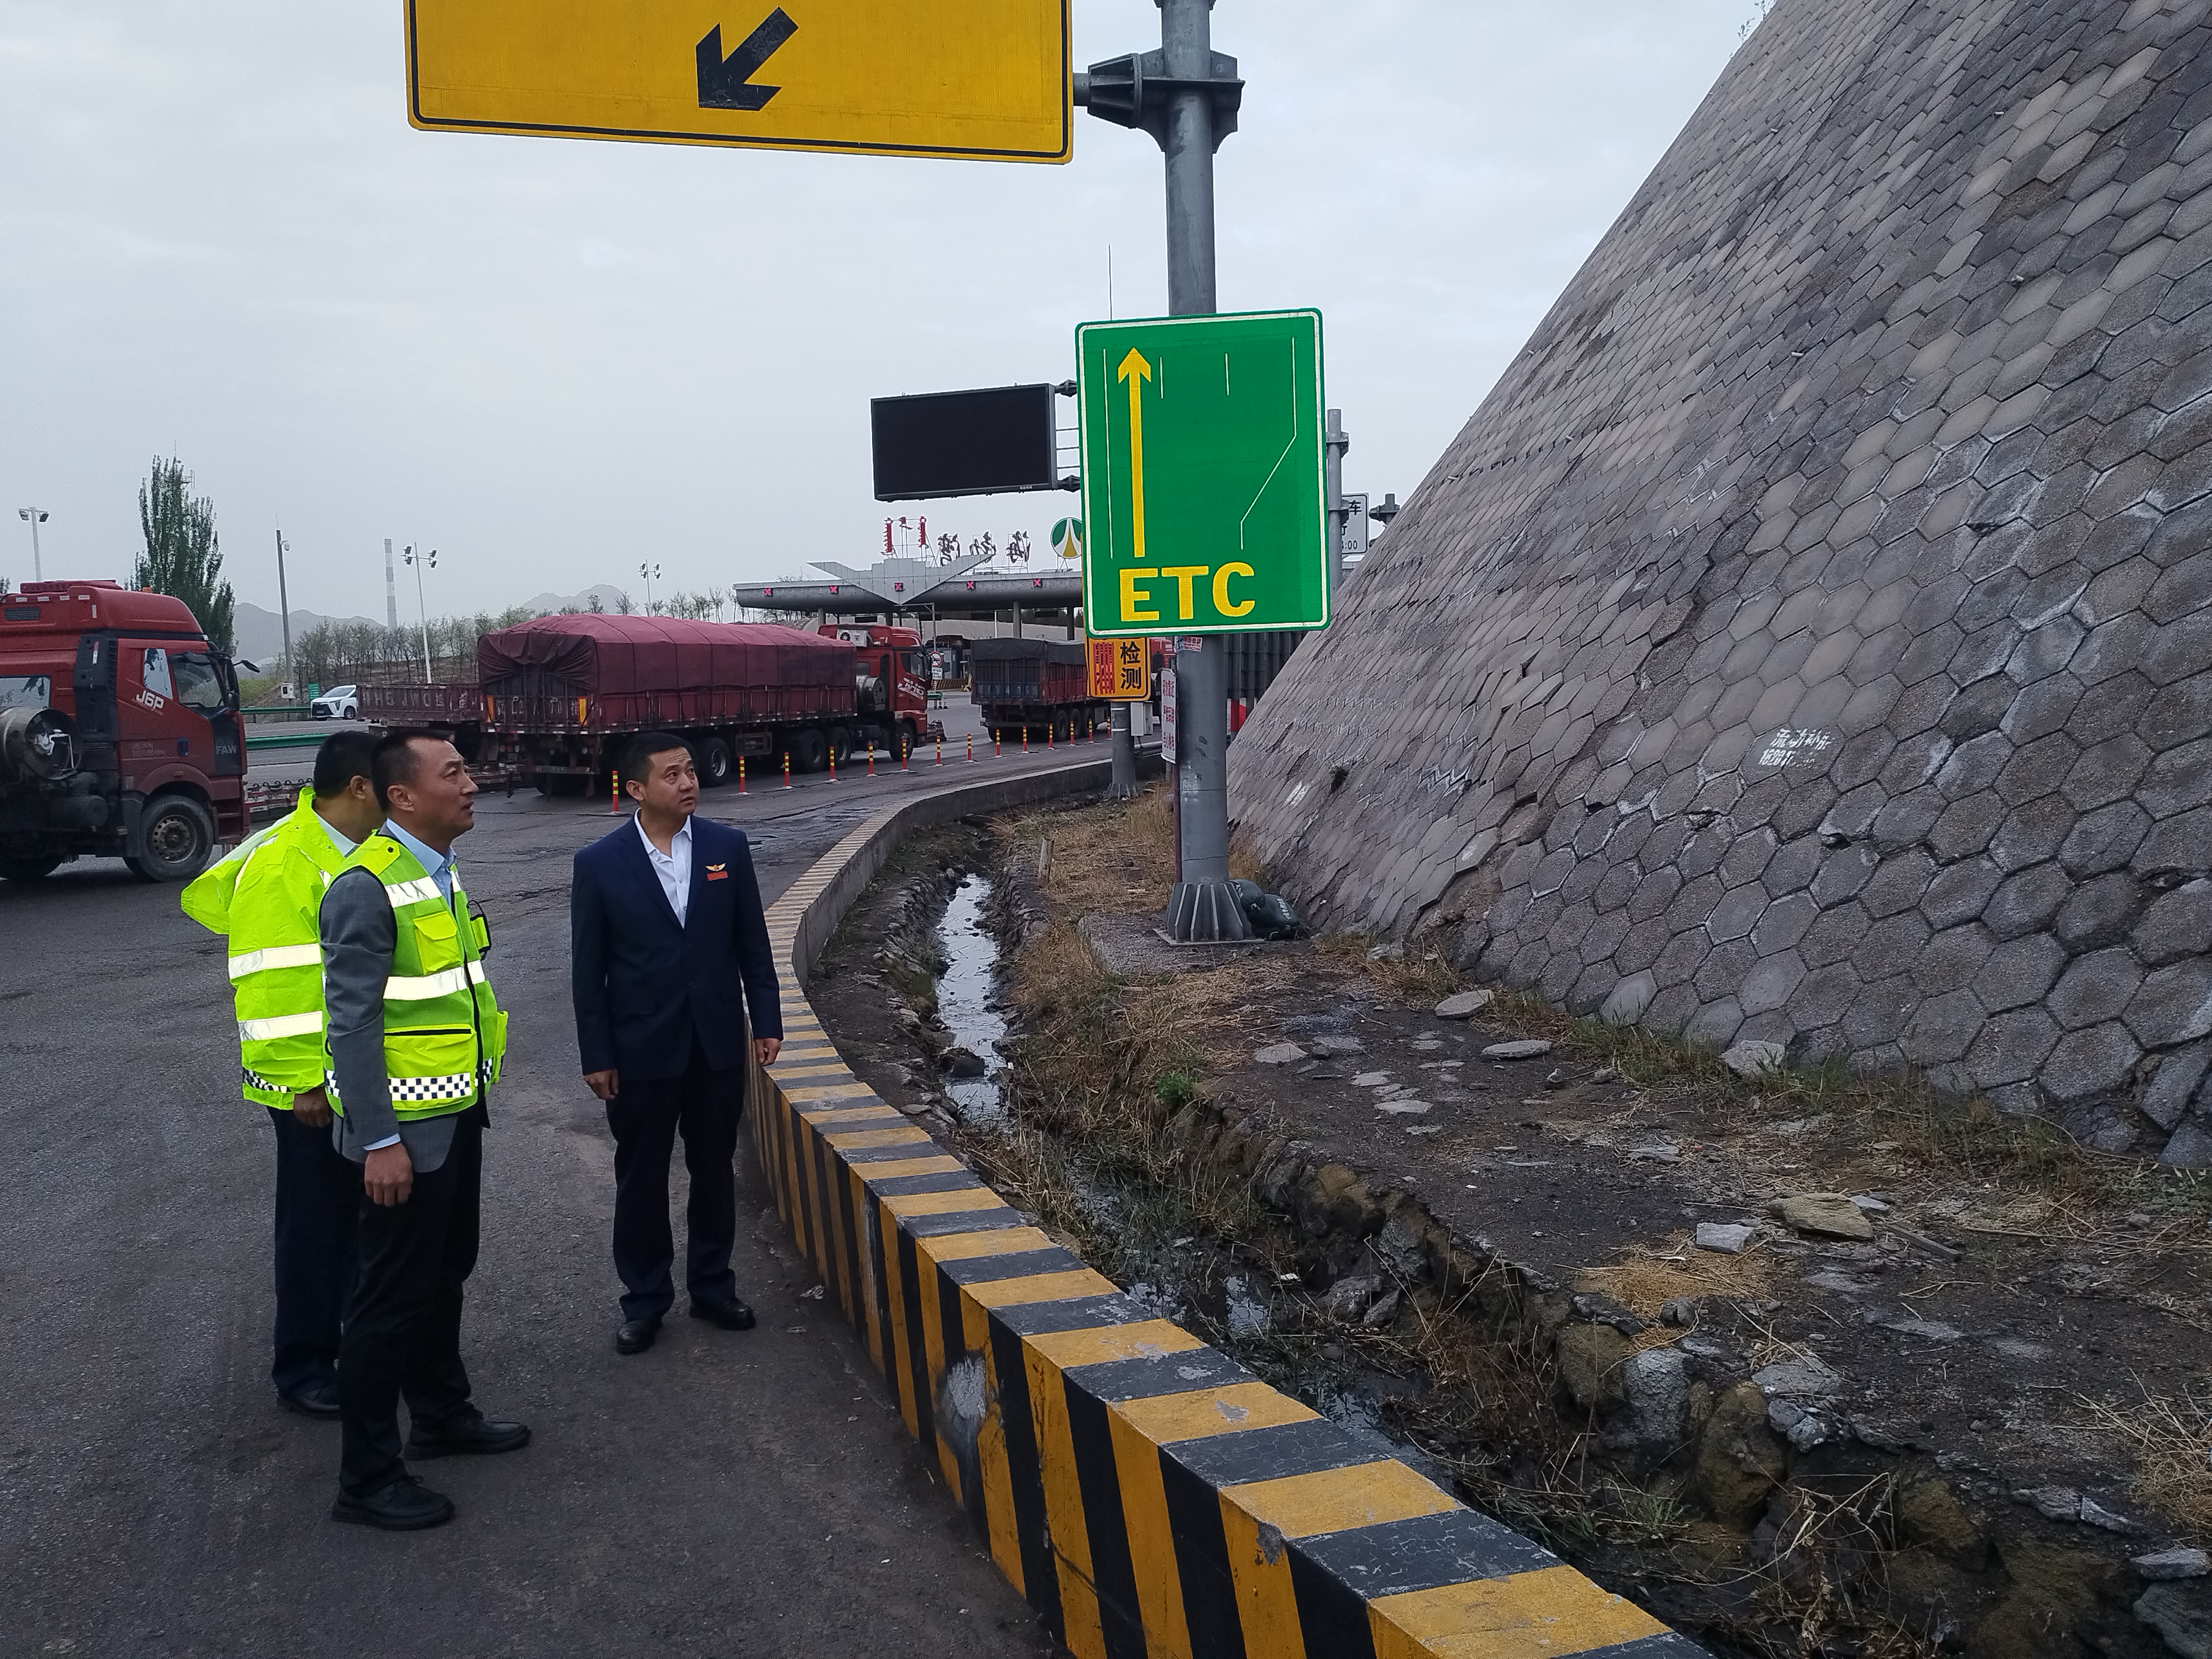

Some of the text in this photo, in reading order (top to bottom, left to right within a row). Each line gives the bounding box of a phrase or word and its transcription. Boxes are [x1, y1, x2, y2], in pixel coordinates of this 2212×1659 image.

[1119, 562, 1255, 622] ETC
[1120, 641, 1141, 690] 检测
[136, 690, 164, 708] J6P
[216, 745, 237, 754] FAW
